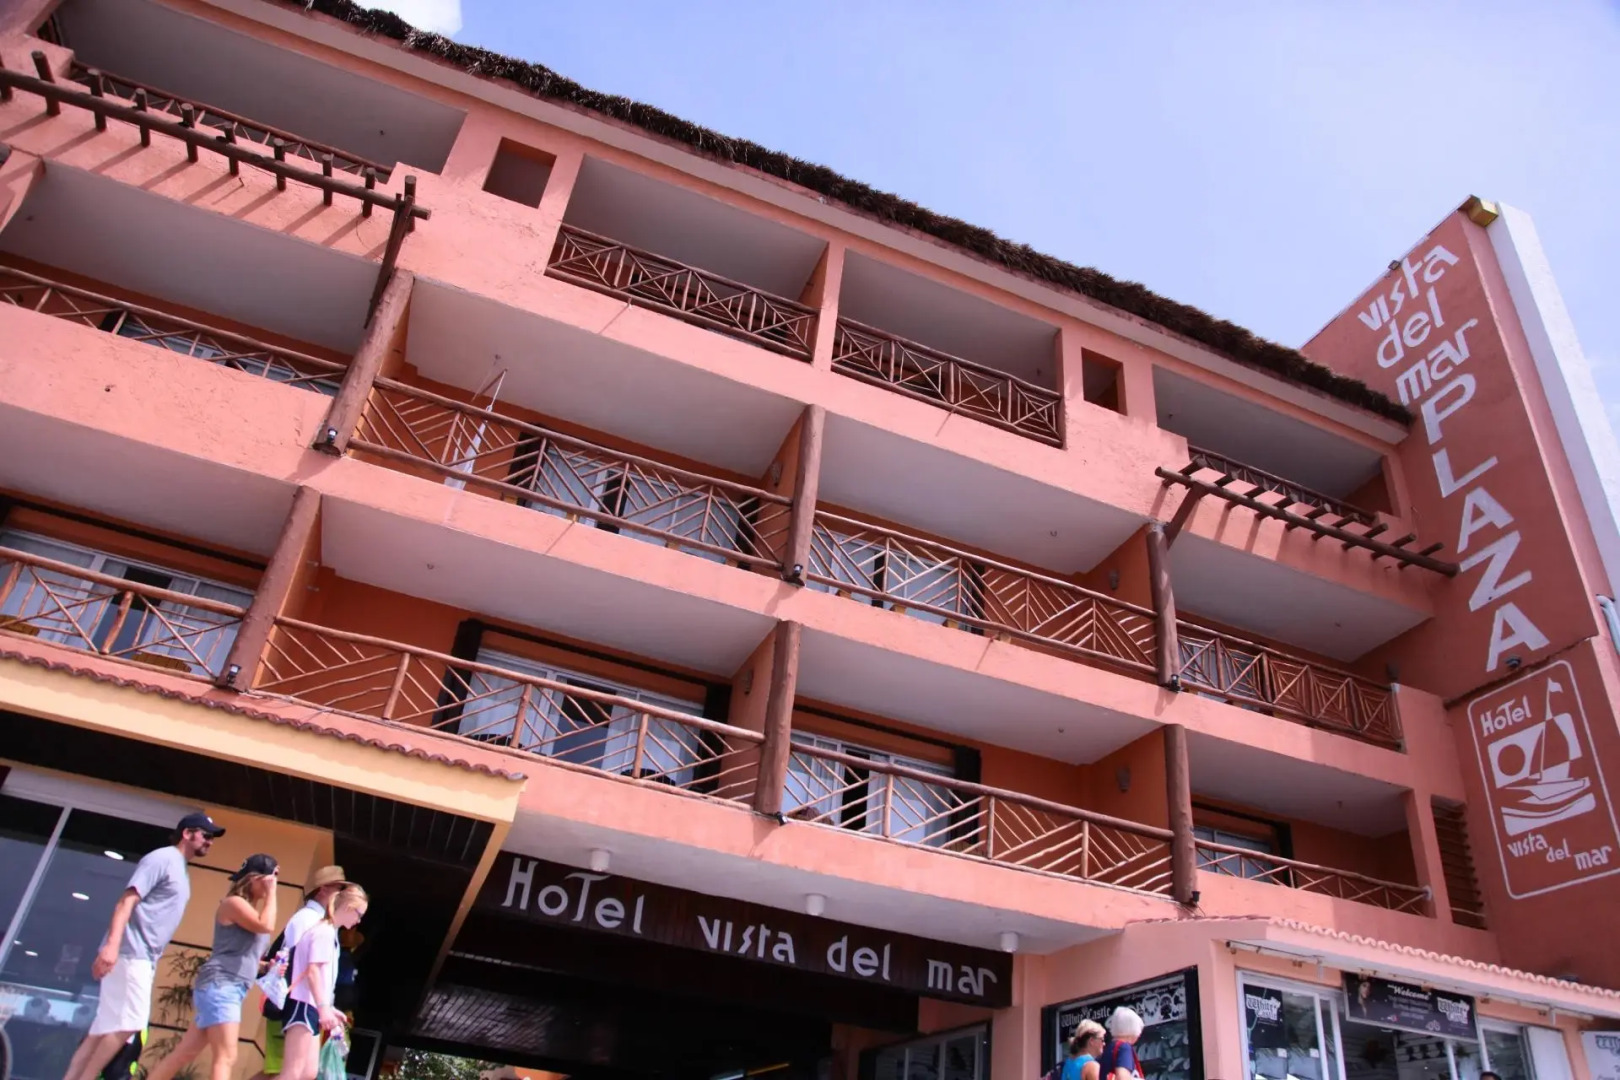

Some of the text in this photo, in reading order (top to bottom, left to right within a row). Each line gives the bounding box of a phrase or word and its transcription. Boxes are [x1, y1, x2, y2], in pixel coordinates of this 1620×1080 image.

[1376, 286, 1445, 369] del
[1395, 318, 1479, 405] mar
[1421, 373, 1550, 673] PLAZA
[1546, 838, 1571, 863] del
[1574, 845, 1612, 871] mar
[827, 935, 892, 982] del
[926, 957, 998, 997] mar
